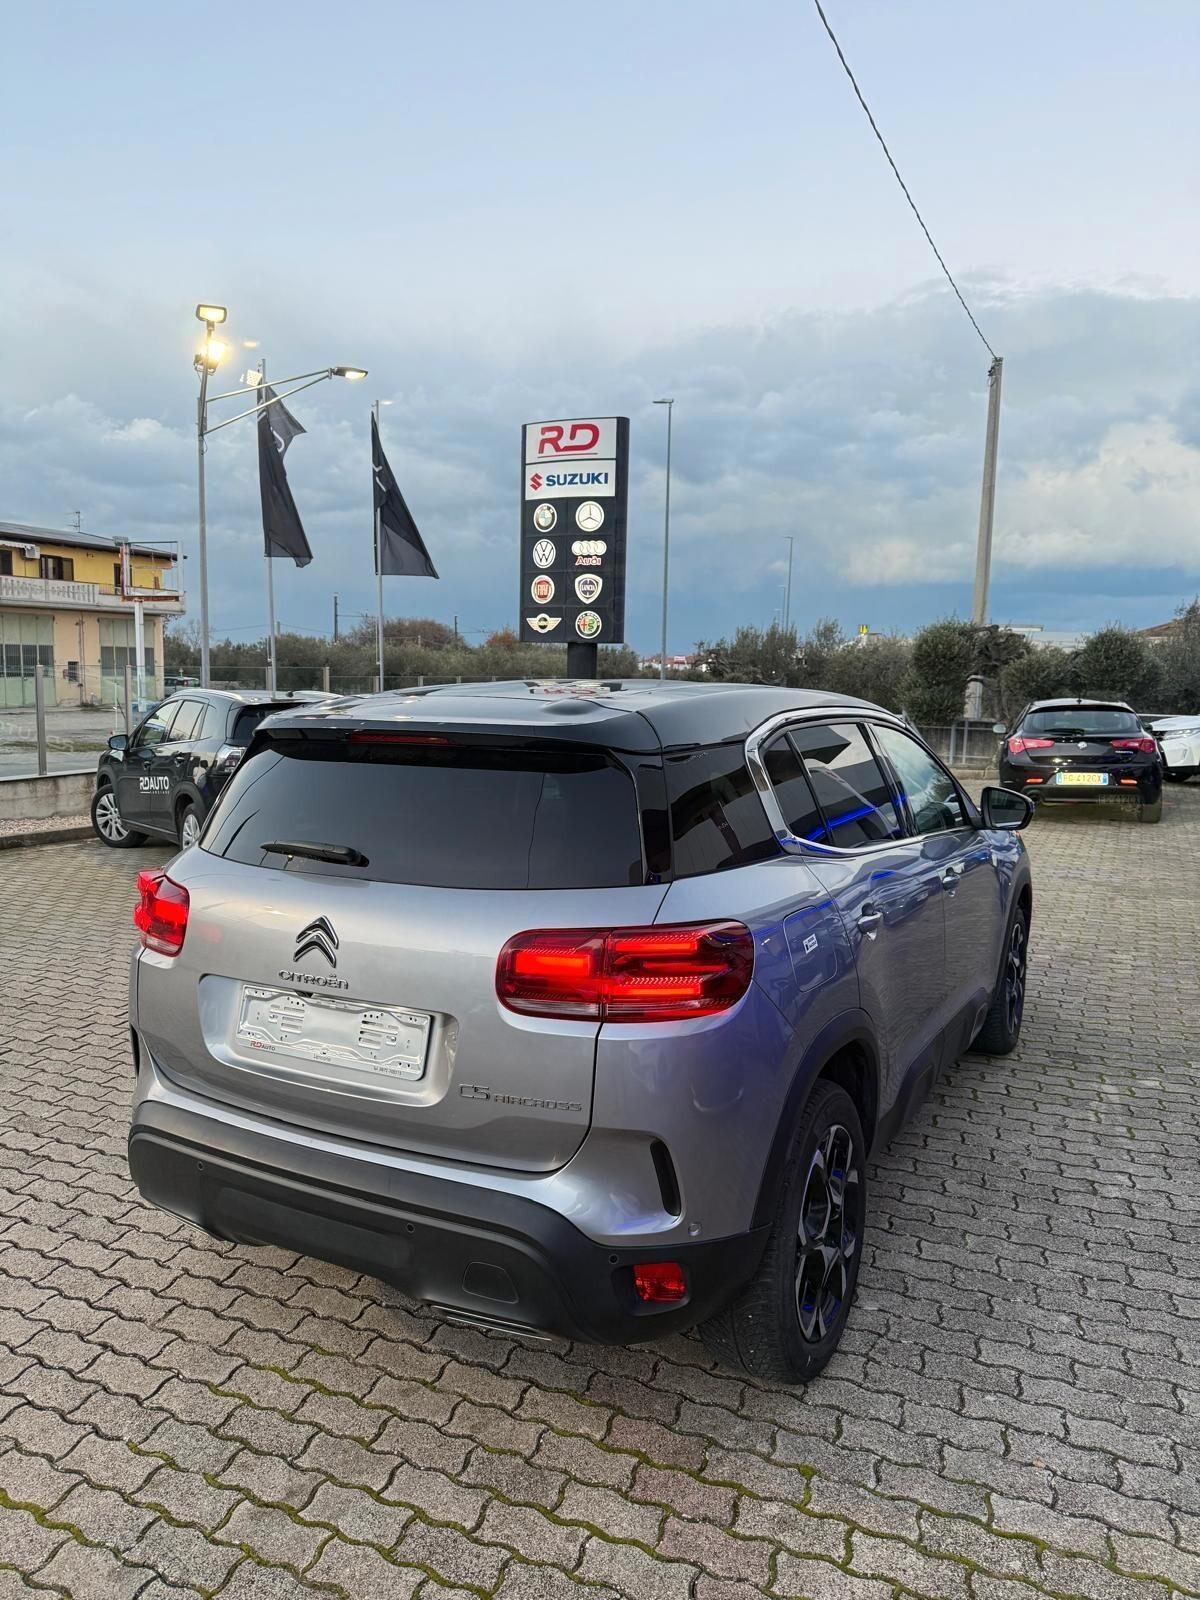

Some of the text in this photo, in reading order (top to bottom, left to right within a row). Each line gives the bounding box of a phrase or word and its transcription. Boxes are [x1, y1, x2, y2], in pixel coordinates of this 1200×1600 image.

[538, 423, 600, 454] RD
[545, 472, 609, 487] SUZUKI
[575, 555, 602, 566] Audi
[459, 1083, 582, 1112] C5 AIRCROSS
